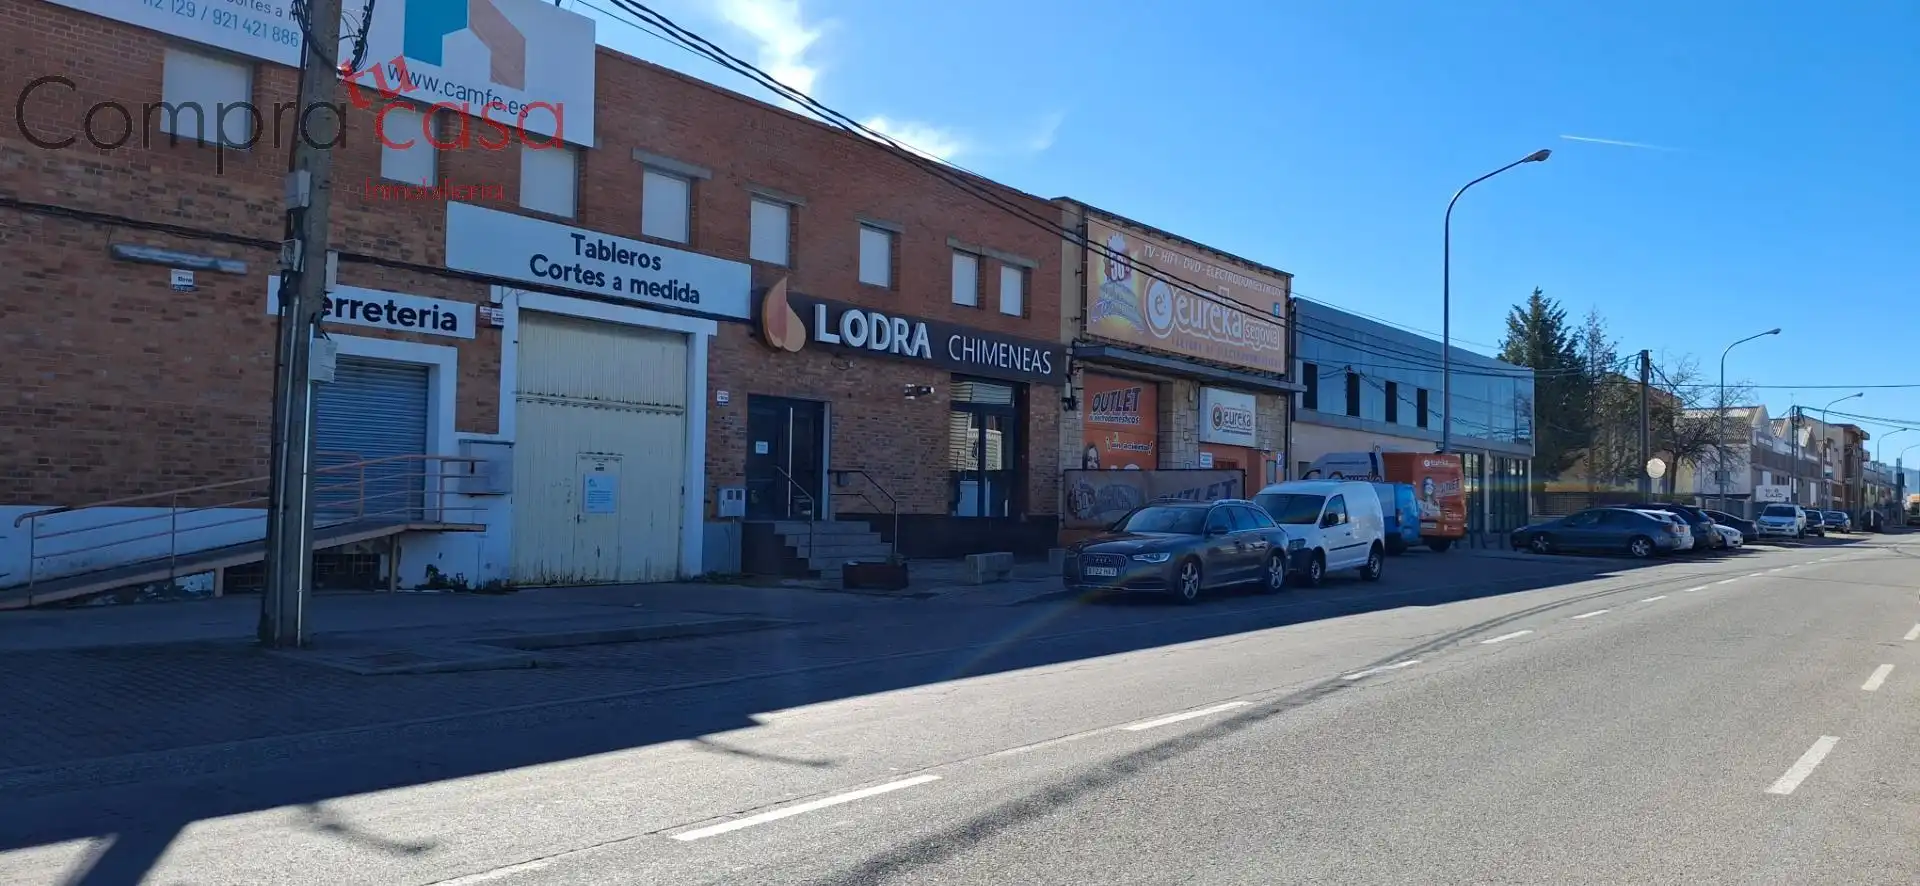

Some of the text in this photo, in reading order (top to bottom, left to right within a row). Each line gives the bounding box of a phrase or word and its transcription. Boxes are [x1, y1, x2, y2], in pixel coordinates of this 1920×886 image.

[227, 0, 271, 14] ortes
[213, 8, 239, 31] 921
[243, 18, 268, 40] 421
[272, 26, 300, 48] 886
[570, 232, 662, 271] Tableros
[1143, 245, 1156, 258] TV
[1183, 257, 1200, 273] DVD
[529, 253, 700, 305] Cortes a medida
[323, 297, 458, 332] erreteria
[1175, 292, 1243, 338] eureka
[814, 303, 1052, 375] LODRA CHIMENEAS
[1091, 387, 1142, 414] OUTLET
